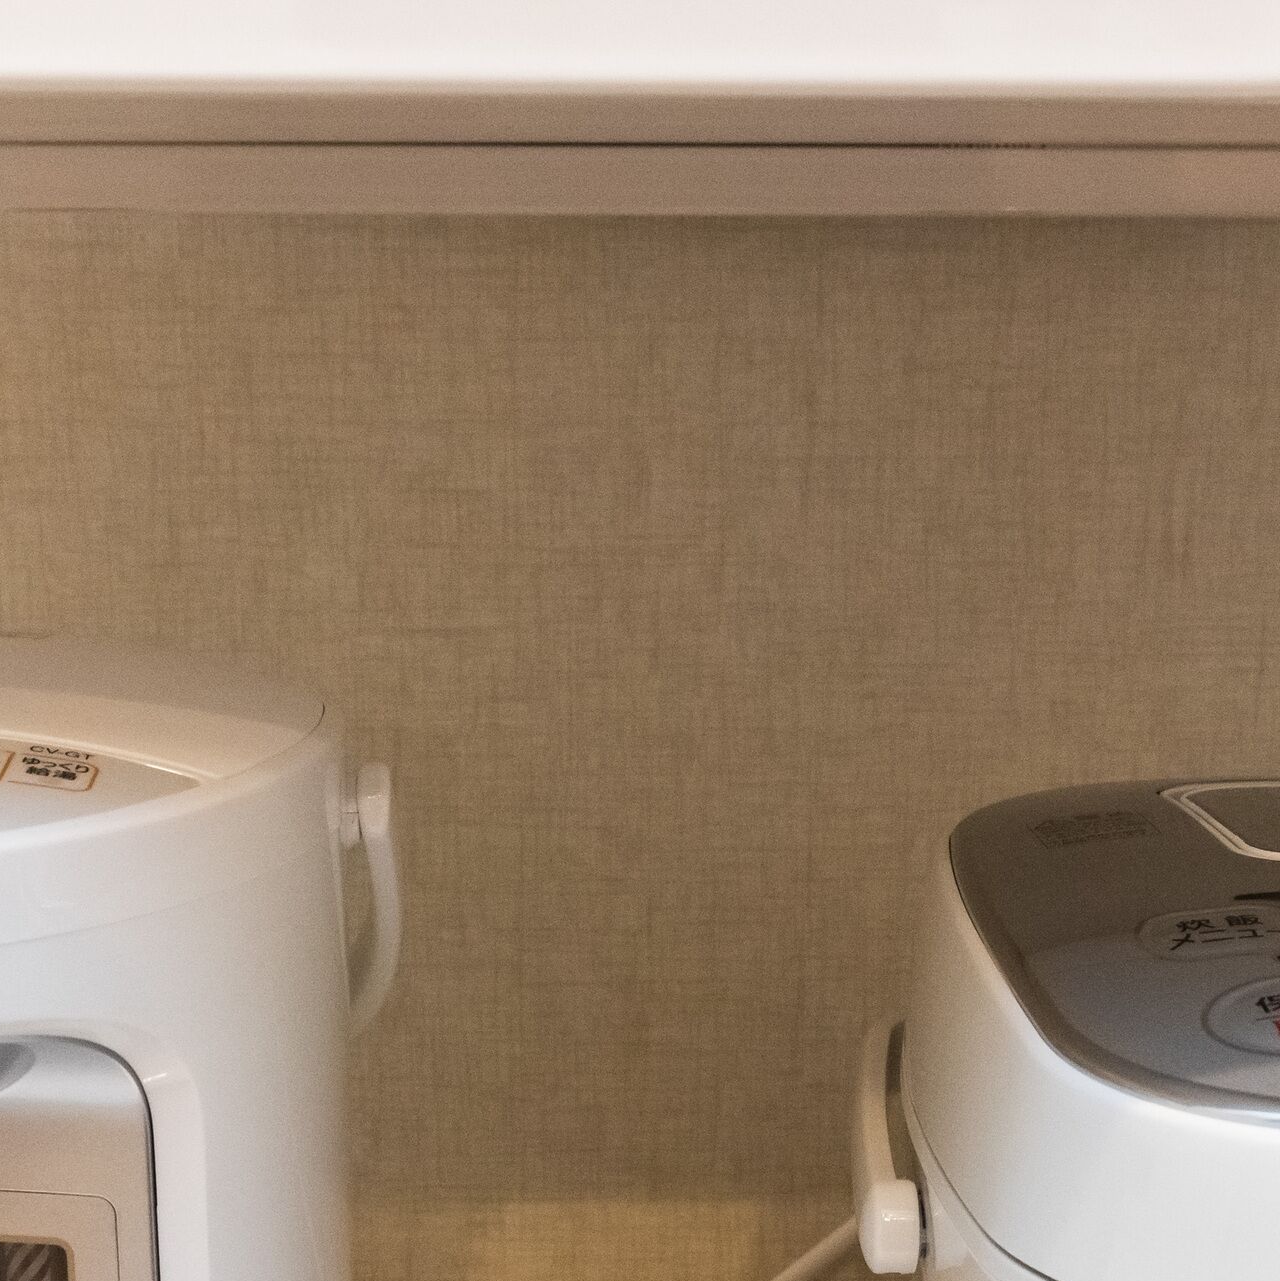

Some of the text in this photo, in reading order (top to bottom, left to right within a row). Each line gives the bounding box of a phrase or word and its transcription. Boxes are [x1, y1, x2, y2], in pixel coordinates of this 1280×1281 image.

[29, 744, 98, 761] CV-GT
[21, 756, 89, 774] ゆっくり
[25, 766, 77, 781] 給湯
[1175, 914, 1264, 932] 炊飯
